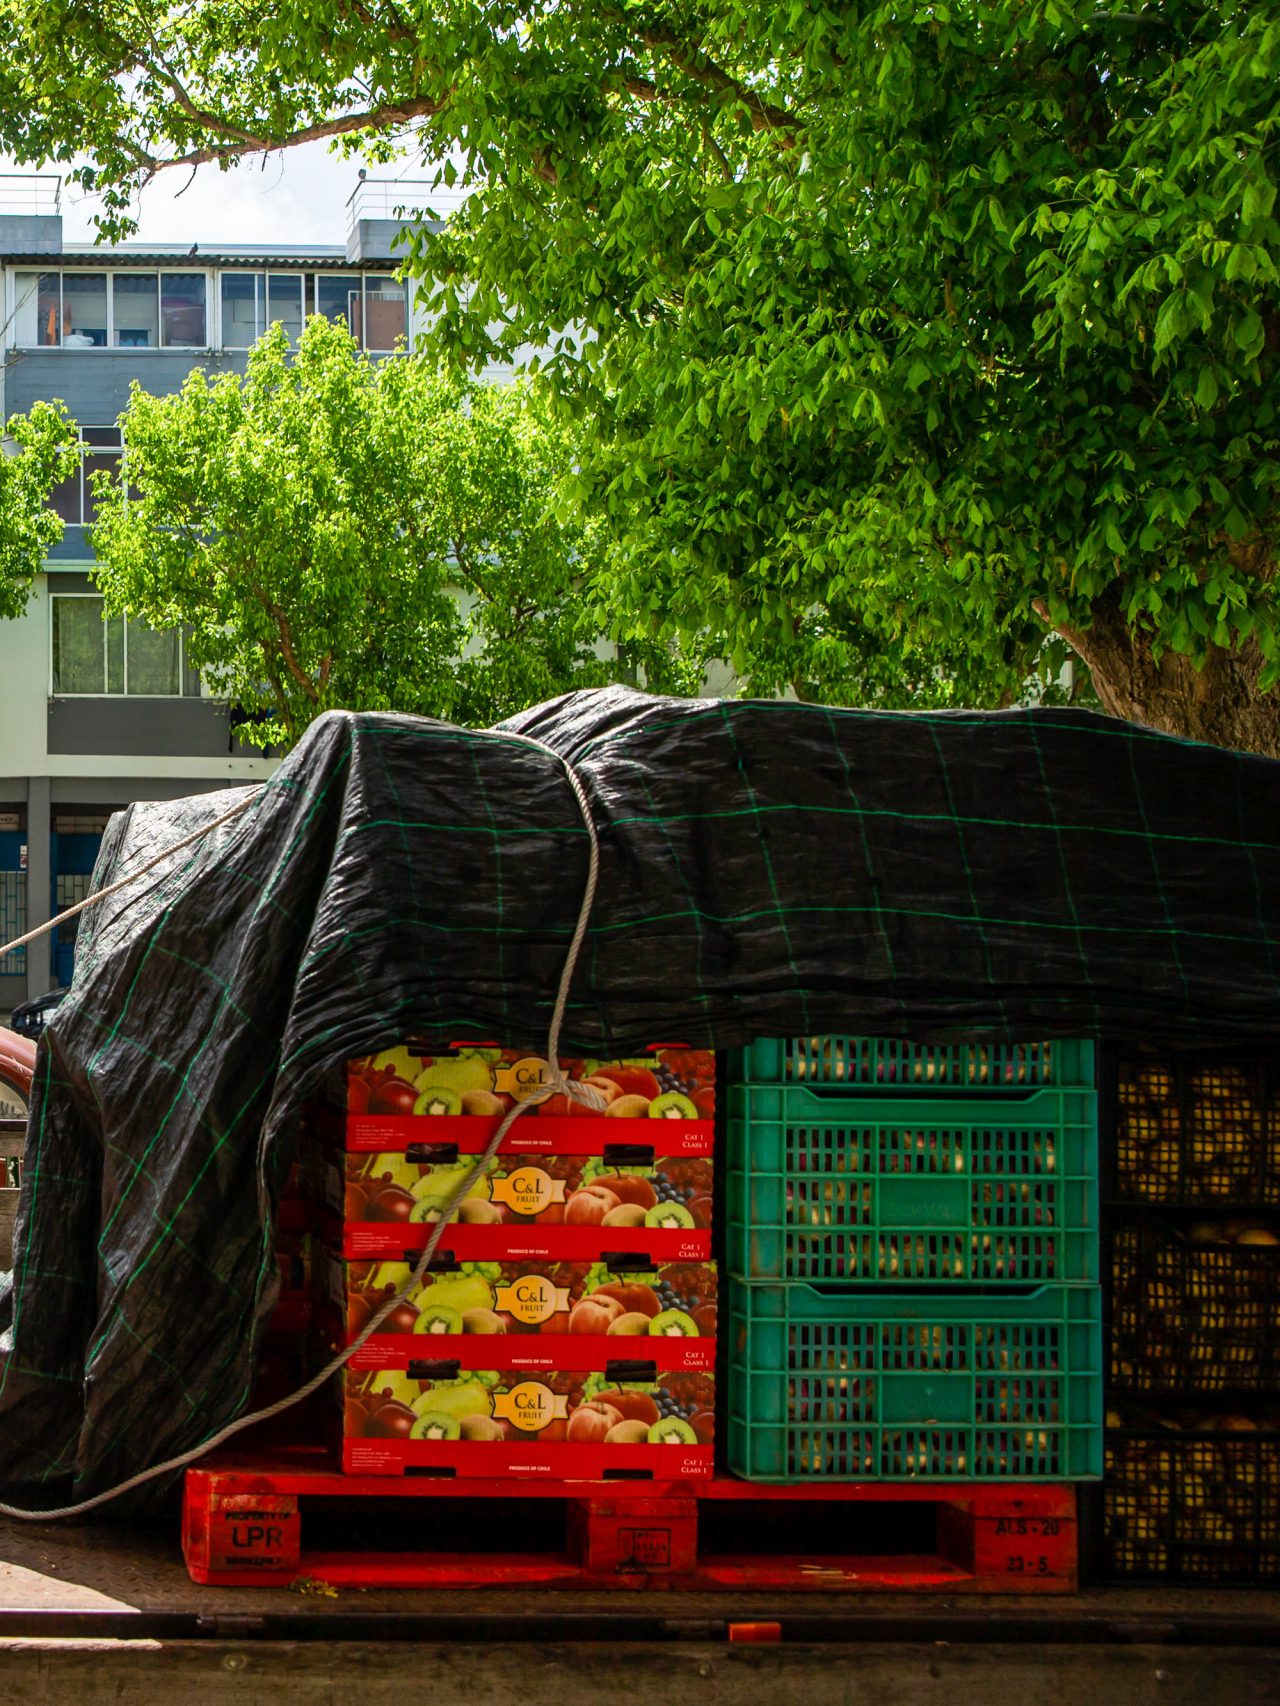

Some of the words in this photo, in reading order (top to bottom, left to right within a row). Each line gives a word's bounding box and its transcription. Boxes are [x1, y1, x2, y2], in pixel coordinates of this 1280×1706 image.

[515, 1068, 548, 1084] C&L
[512, 1177, 544, 1194] C&L
[516, 1286, 548, 1303] C&L
[520, 1304, 545, 1312] FRUIT
[514, 1392, 546, 1409] C&L
[518, 1411, 544, 1419] FRUIT
[225, 1512, 276, 1521] PROPERTY
[1040, 1518, 1060, 1536] 20
[232, 1526, 283, 1548] LPR
[1006, 1556, 1025, 1572] 23
[1038, 1556, 1048, 1572] 5
